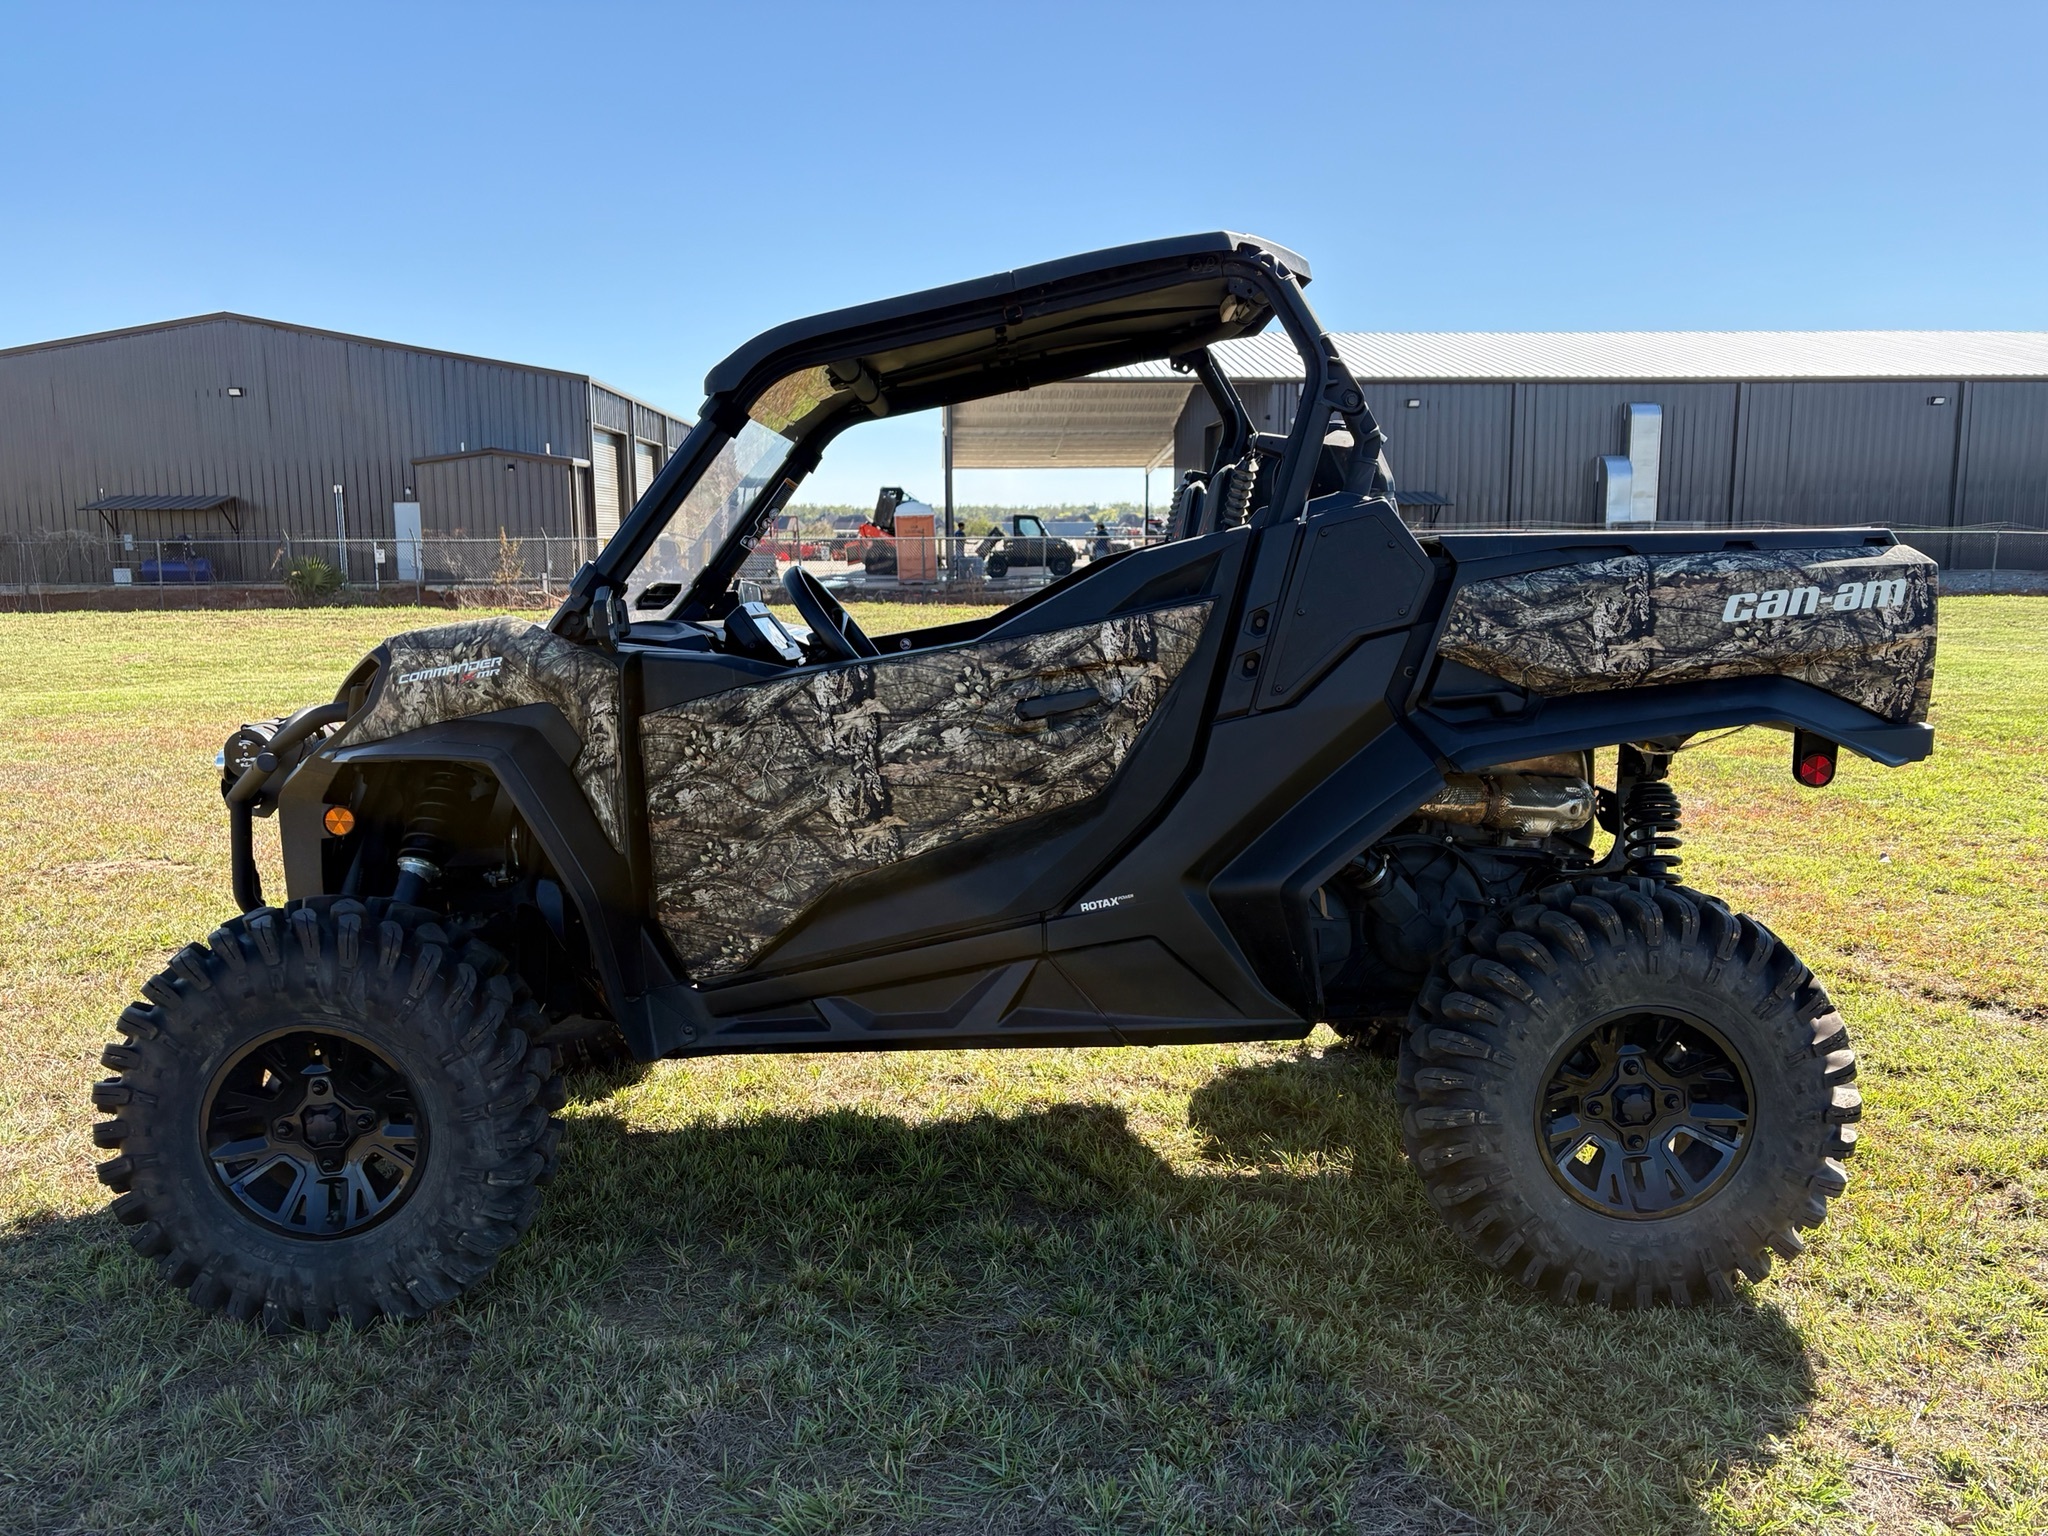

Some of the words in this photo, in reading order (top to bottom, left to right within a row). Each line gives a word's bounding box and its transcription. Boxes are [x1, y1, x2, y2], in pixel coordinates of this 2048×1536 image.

[1722, 578, 1907, 623] can-am
[398, 656, 503, 684] COMMANDER
[1080, 896, 1119, 912] ROTAX
